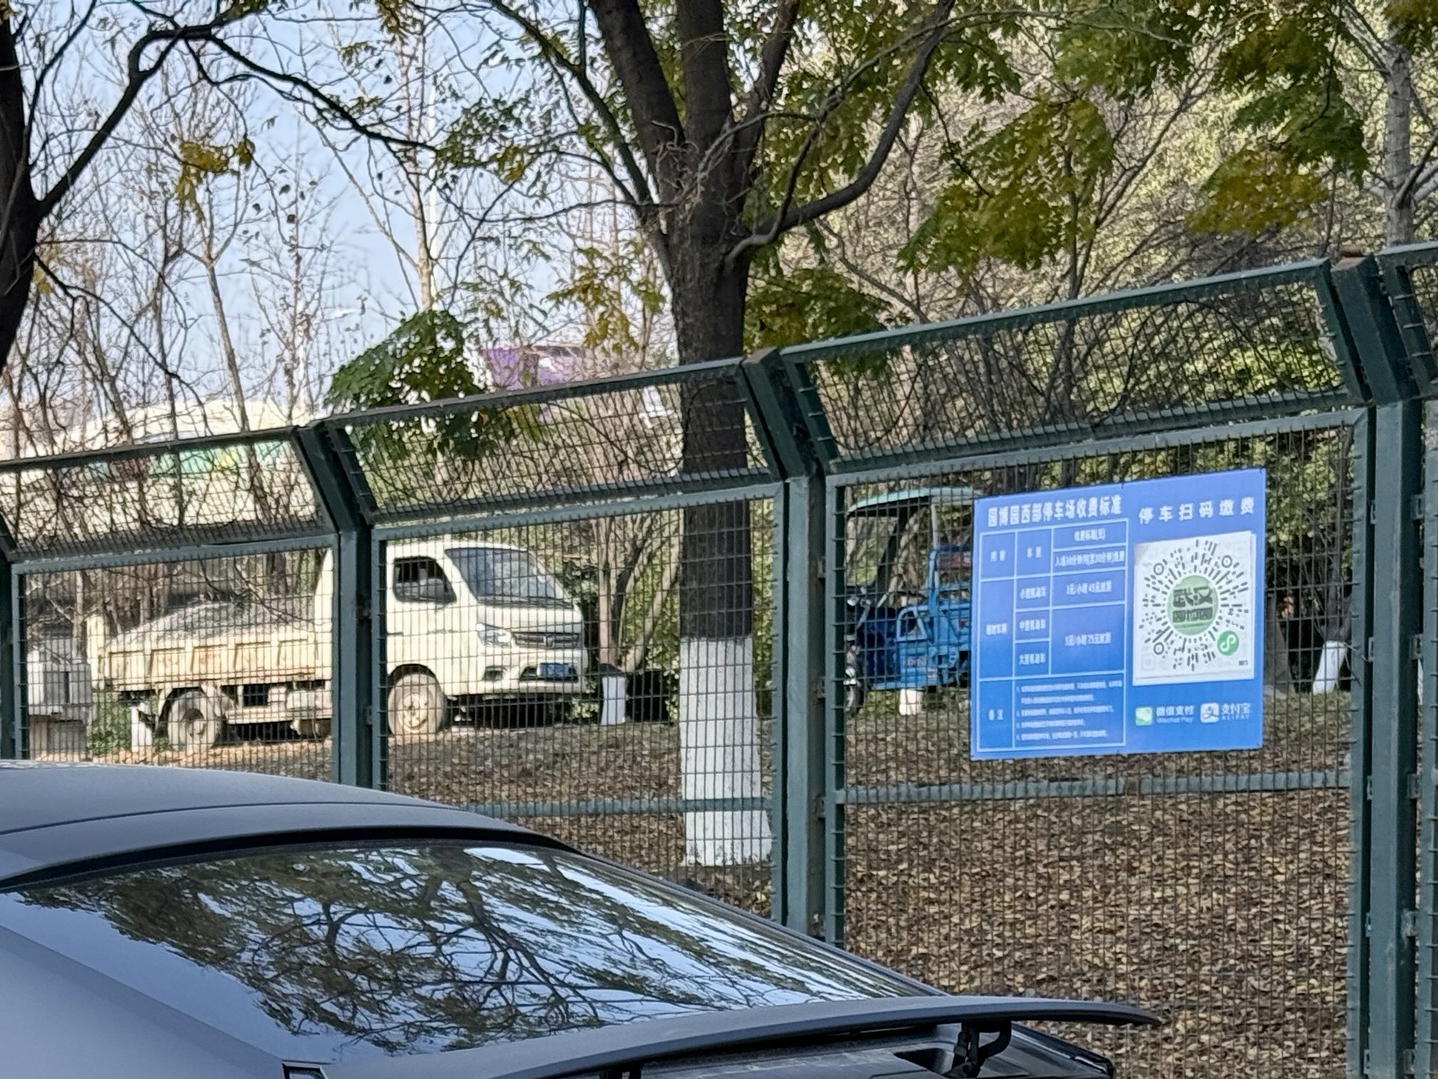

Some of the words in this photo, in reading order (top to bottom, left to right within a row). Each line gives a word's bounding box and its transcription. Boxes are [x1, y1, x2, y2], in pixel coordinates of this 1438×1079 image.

[1138, 496, 1255, 525] 停车扫码缴费
[1221, 702, 1251, 715] 支付宝
